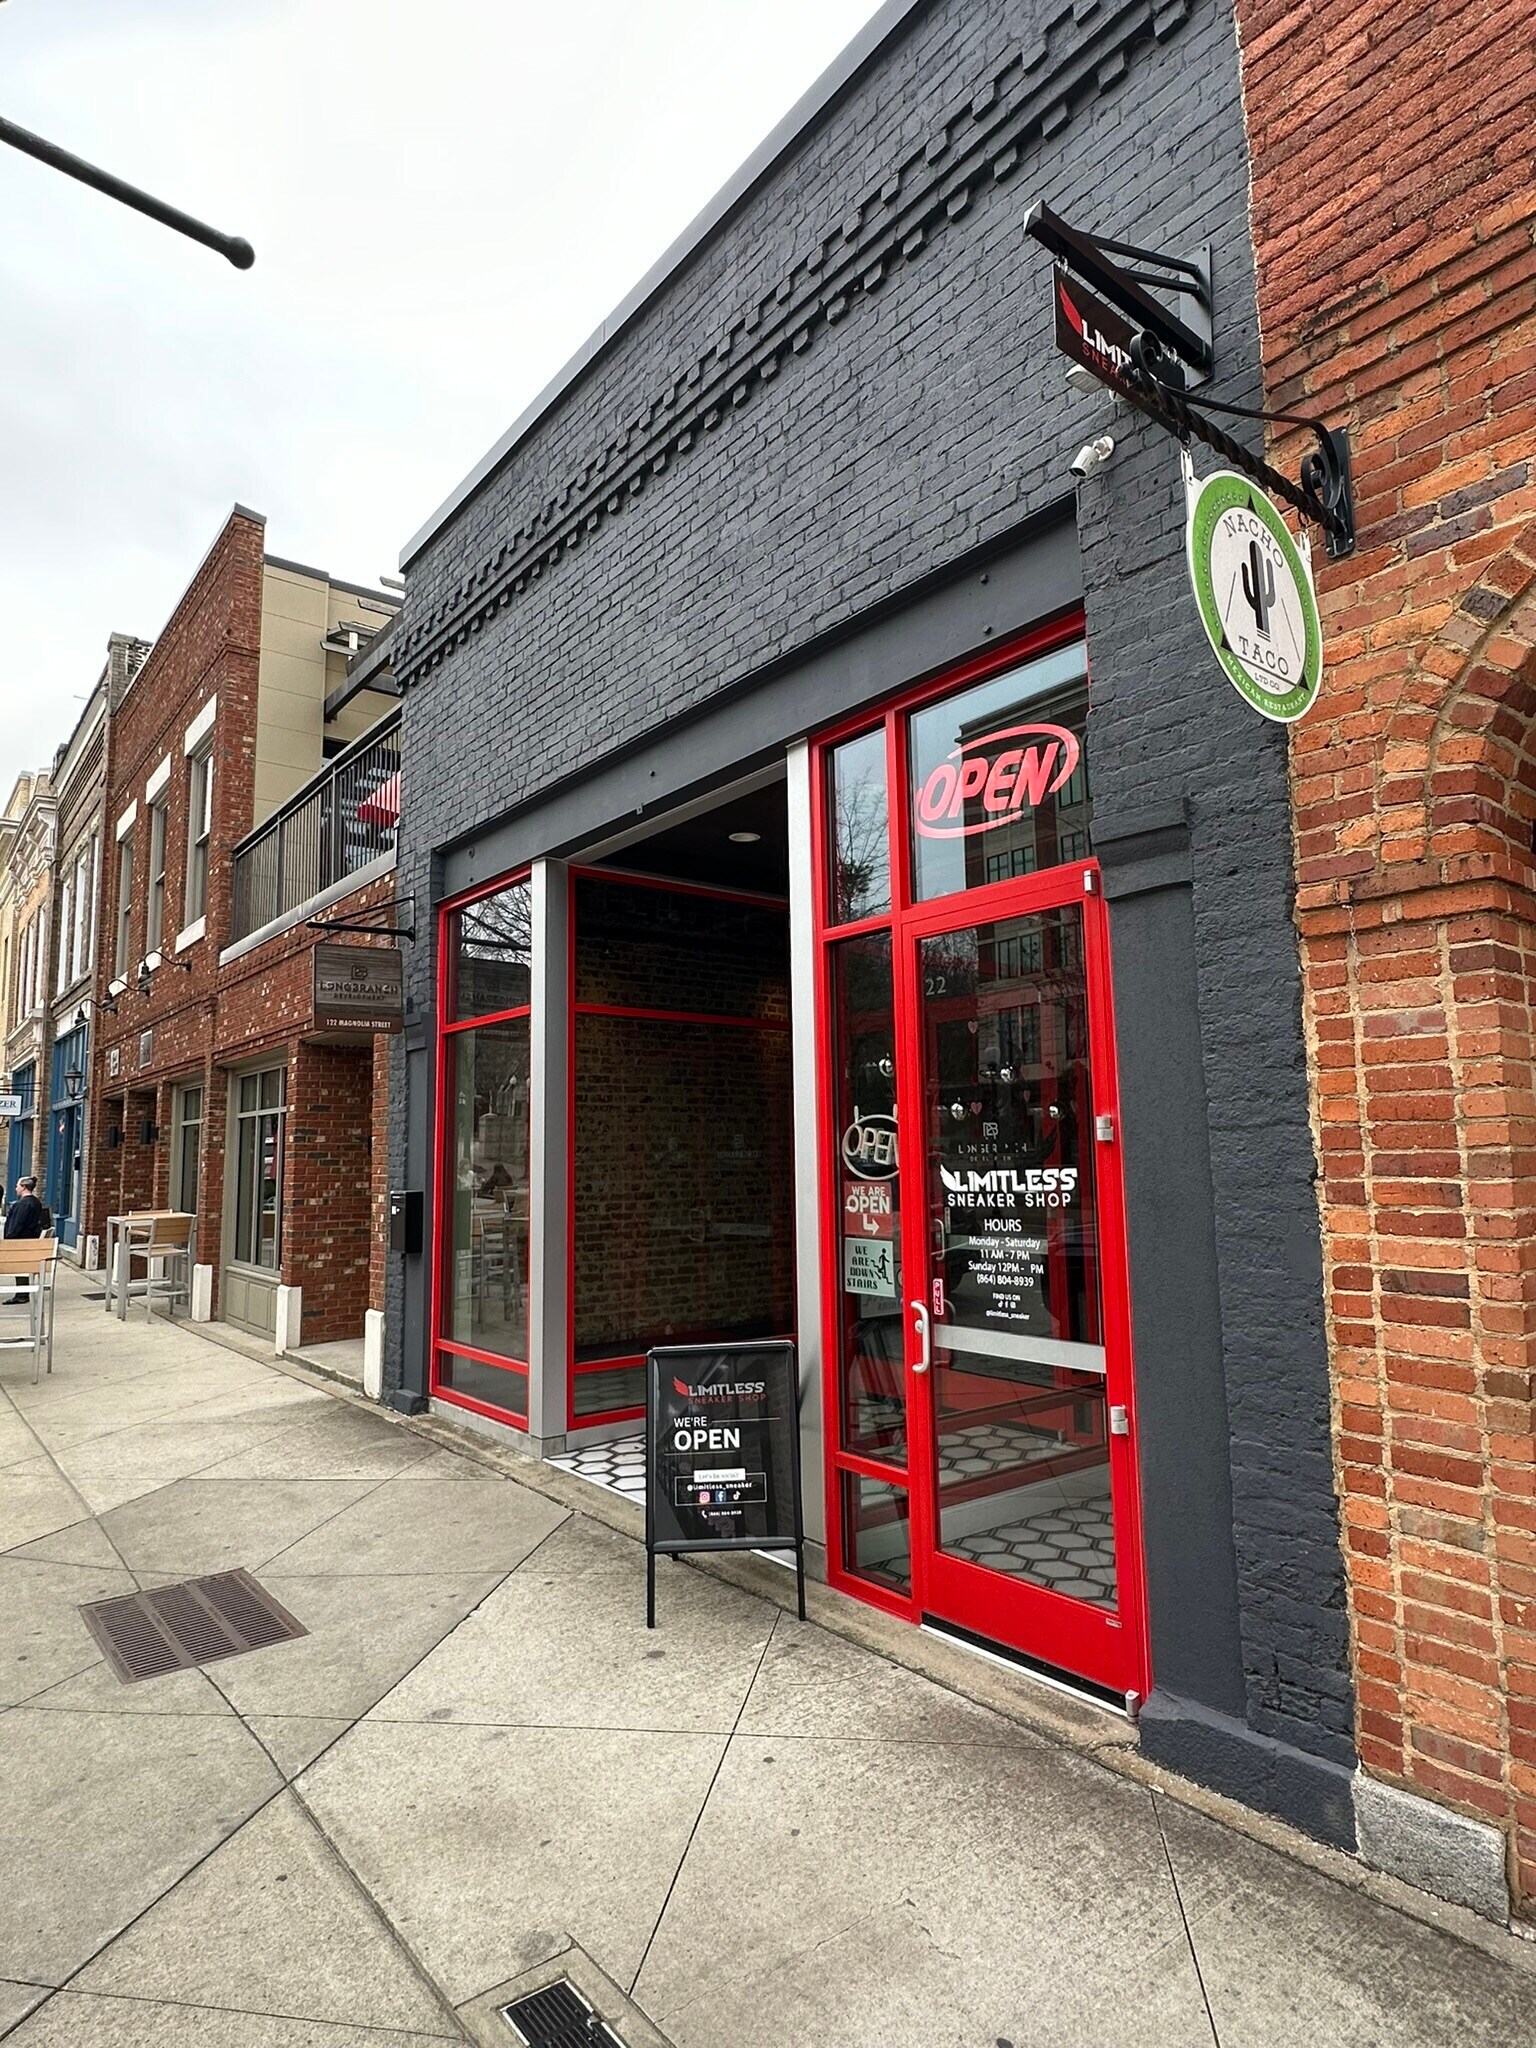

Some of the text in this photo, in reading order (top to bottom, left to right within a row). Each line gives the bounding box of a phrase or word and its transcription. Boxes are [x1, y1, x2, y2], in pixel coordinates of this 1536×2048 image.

[1081, 318, 1133, 368] LIMIT
[1222, 513, 1284, 568] NACHO
[1238, 635, 1289, 676] TACO
[920, 741, 1059, 821] OPEN
[320, 981, 398, 995] LONGBRANCH
[326, 1019, 392, 1029] 122 MAGNOLIA STREET
[953, 1167, 1078, 1194] LIMITLESS
[851, 1185, 886, 1197] WE ARE
[846, 1194, 891, 1214] OPEN
[947, 1193, 1072, 1207] SNEAKER SHOP
[983, 1218, 1022, 1232] HOURS
[968, 1236, 1000, 1249] Monday
[1005, 1237, 1041, 1250] Saturday
[854, 1245, 868, 1256] WE
[980, 1249, 989, 1259] 11
[990, 1249, 1005, 1259] AM
[1010, 1250, 1015, 1260] 7
[1016, 1250, 1030, 1260] PM
[851, 1256, 870, 1267] ARE
[968, 1260, 997, 1273] Sunday
[998, 1262, 1020, 1273] 12PM
[1030, 1263, 1044, 1274] PM
[849, 1266, 875, 1279] DOWN
[976, 1274, 996, 1285] (864)
[846, 1278, 878, 1290] STAIRS
[687, 1381, 766, 1397] LIMITLESS
[687, 1393, 767, 1405] SNEAKER SHOP
[673, 1416, 708, 1428] WE'RE
[674, 1428, 741, 1451] OPEN
